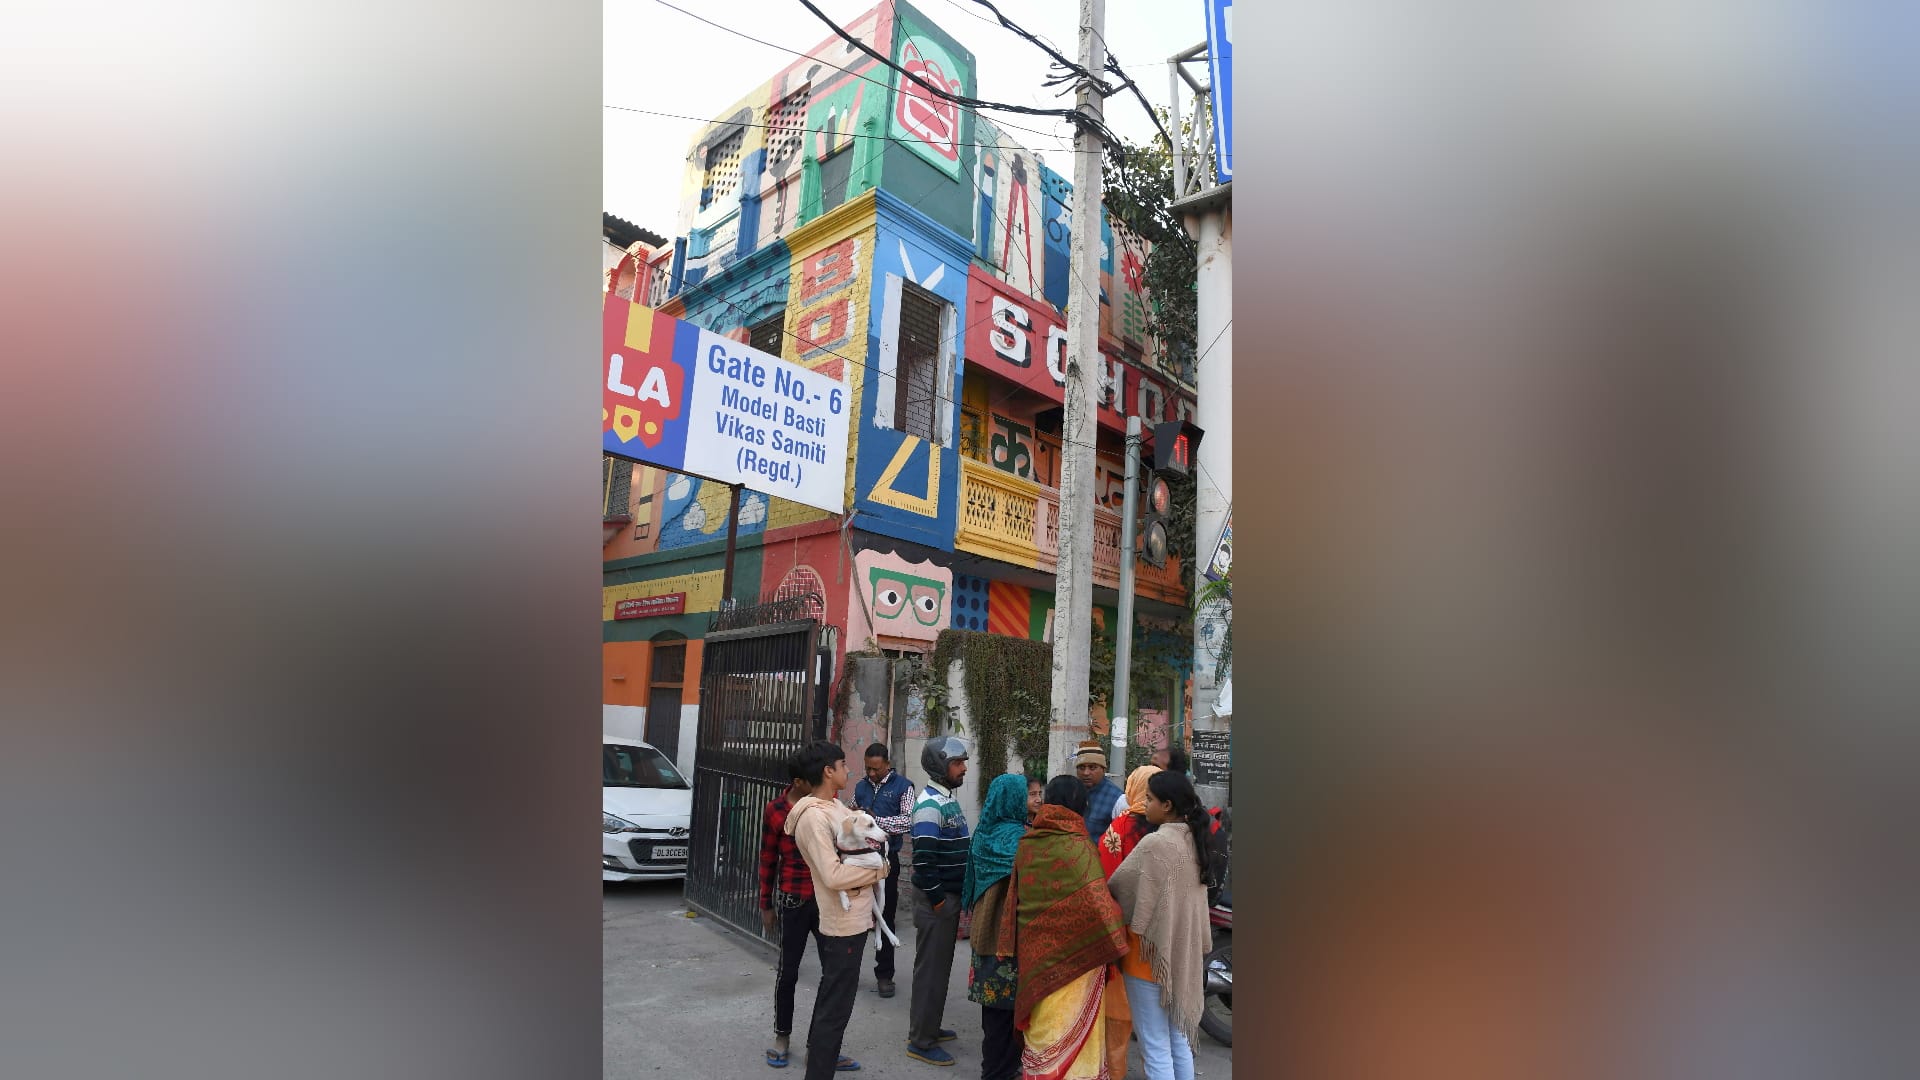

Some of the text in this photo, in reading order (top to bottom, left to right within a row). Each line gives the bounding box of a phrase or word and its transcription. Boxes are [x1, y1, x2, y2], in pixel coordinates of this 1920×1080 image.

[607, 353, 671, 408] LA
[708, 344, 766, 388] Gate
[829, 388, 843, 415] 6
[715, 410, 826, 465] Vikas Samiti
[721, 384, 826, 437] Model Basti
[736, 447, 803, 488] (Regd.)
